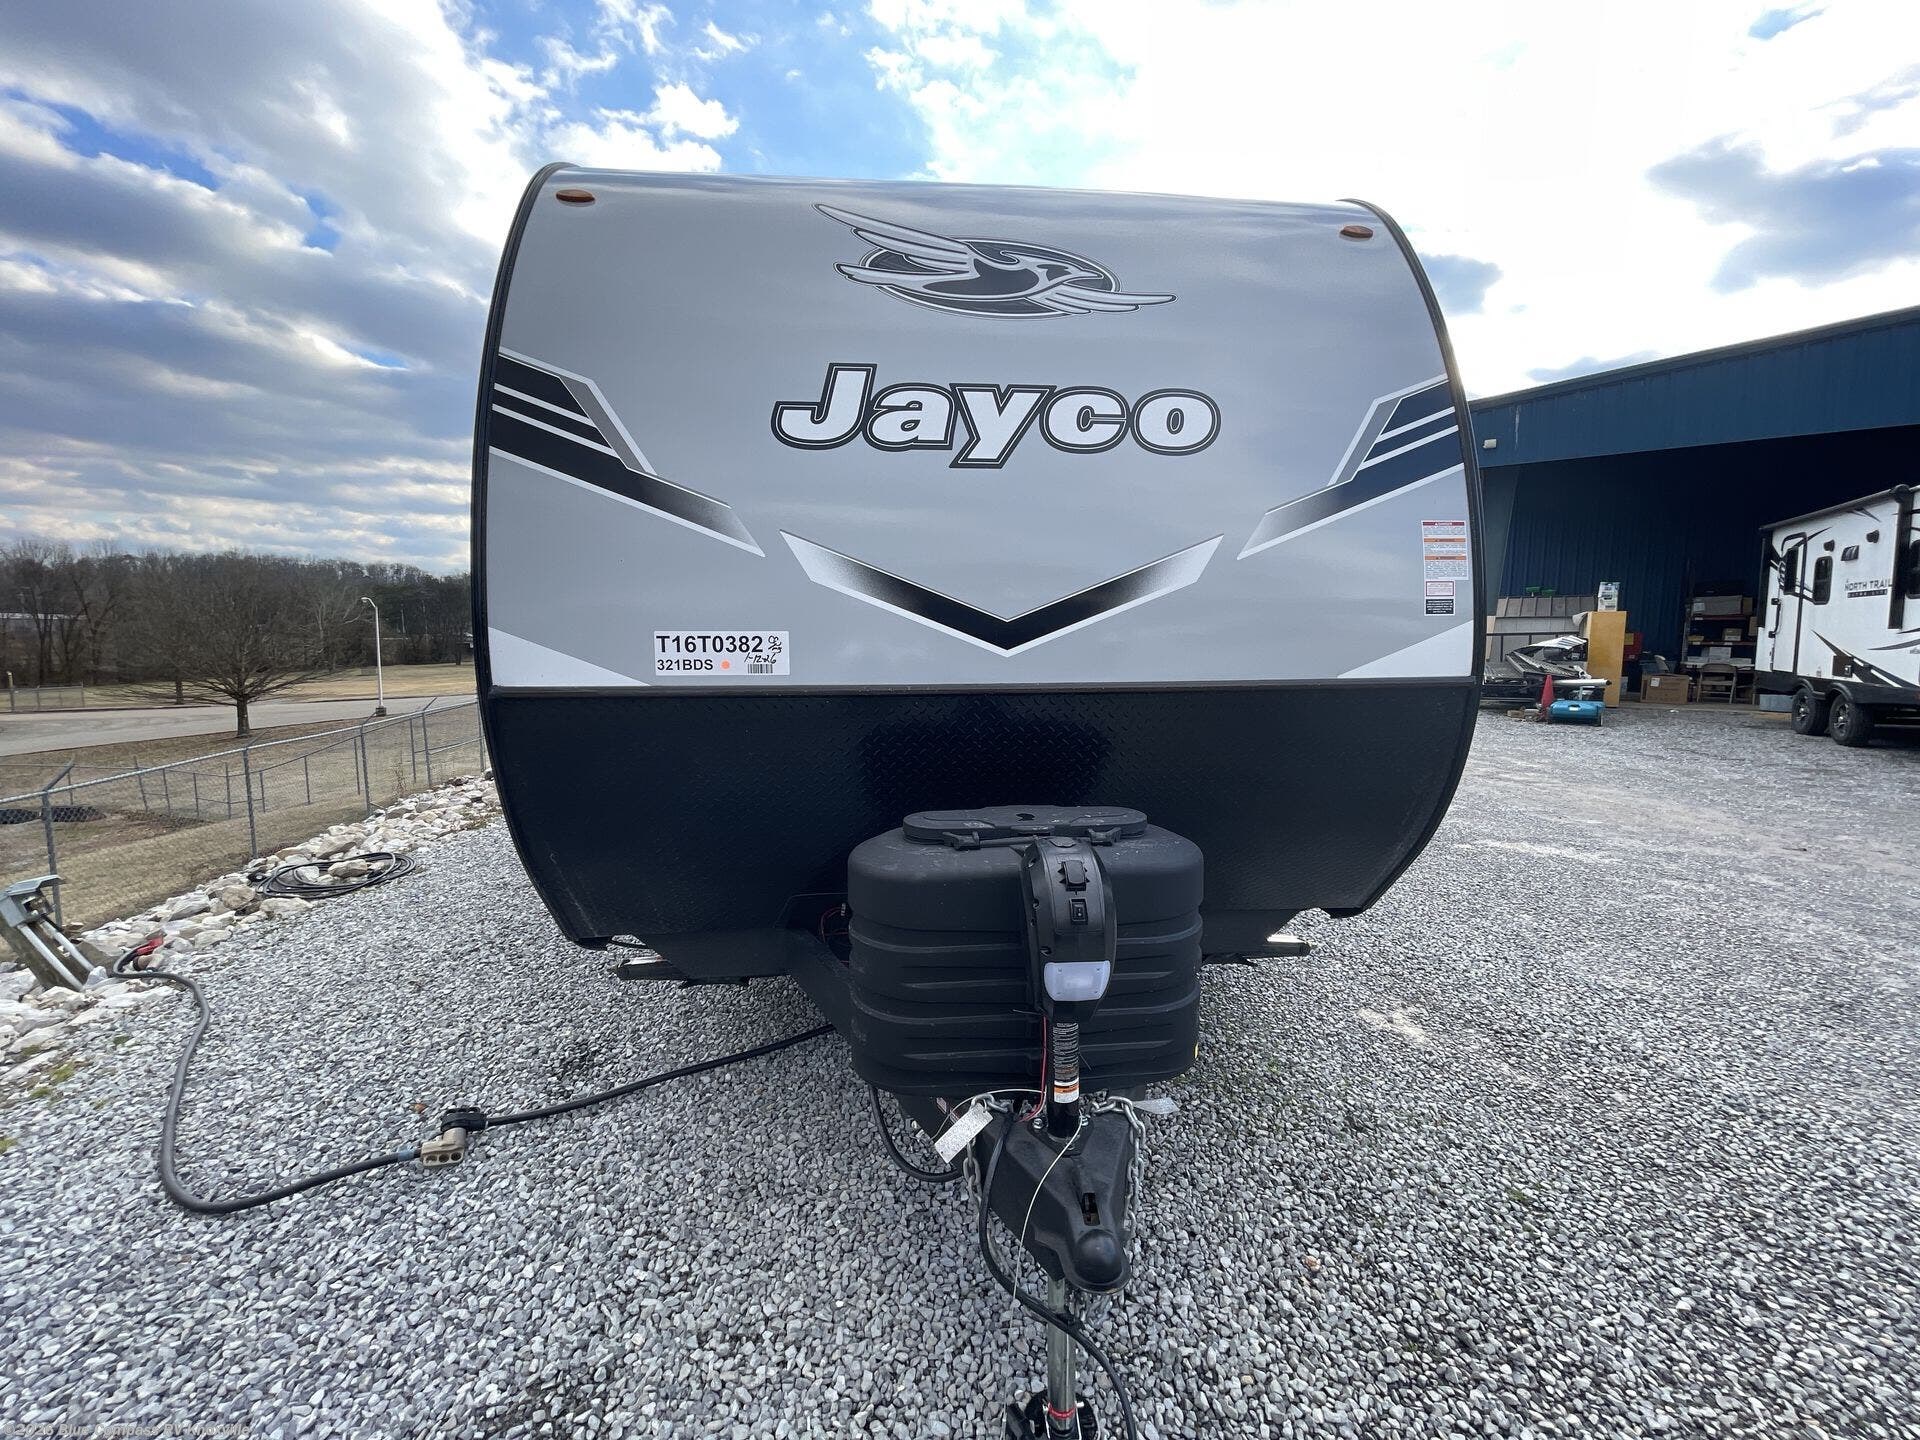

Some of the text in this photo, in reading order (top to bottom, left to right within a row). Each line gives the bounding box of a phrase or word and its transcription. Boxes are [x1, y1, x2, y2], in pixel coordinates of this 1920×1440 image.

[771, 363, 1221, 469] Jayco
[1845, 582, 1868, 592] NORTH
[656, 635, 763, 653] T16T0382
[657, 659, 713, 670] 321BDS
